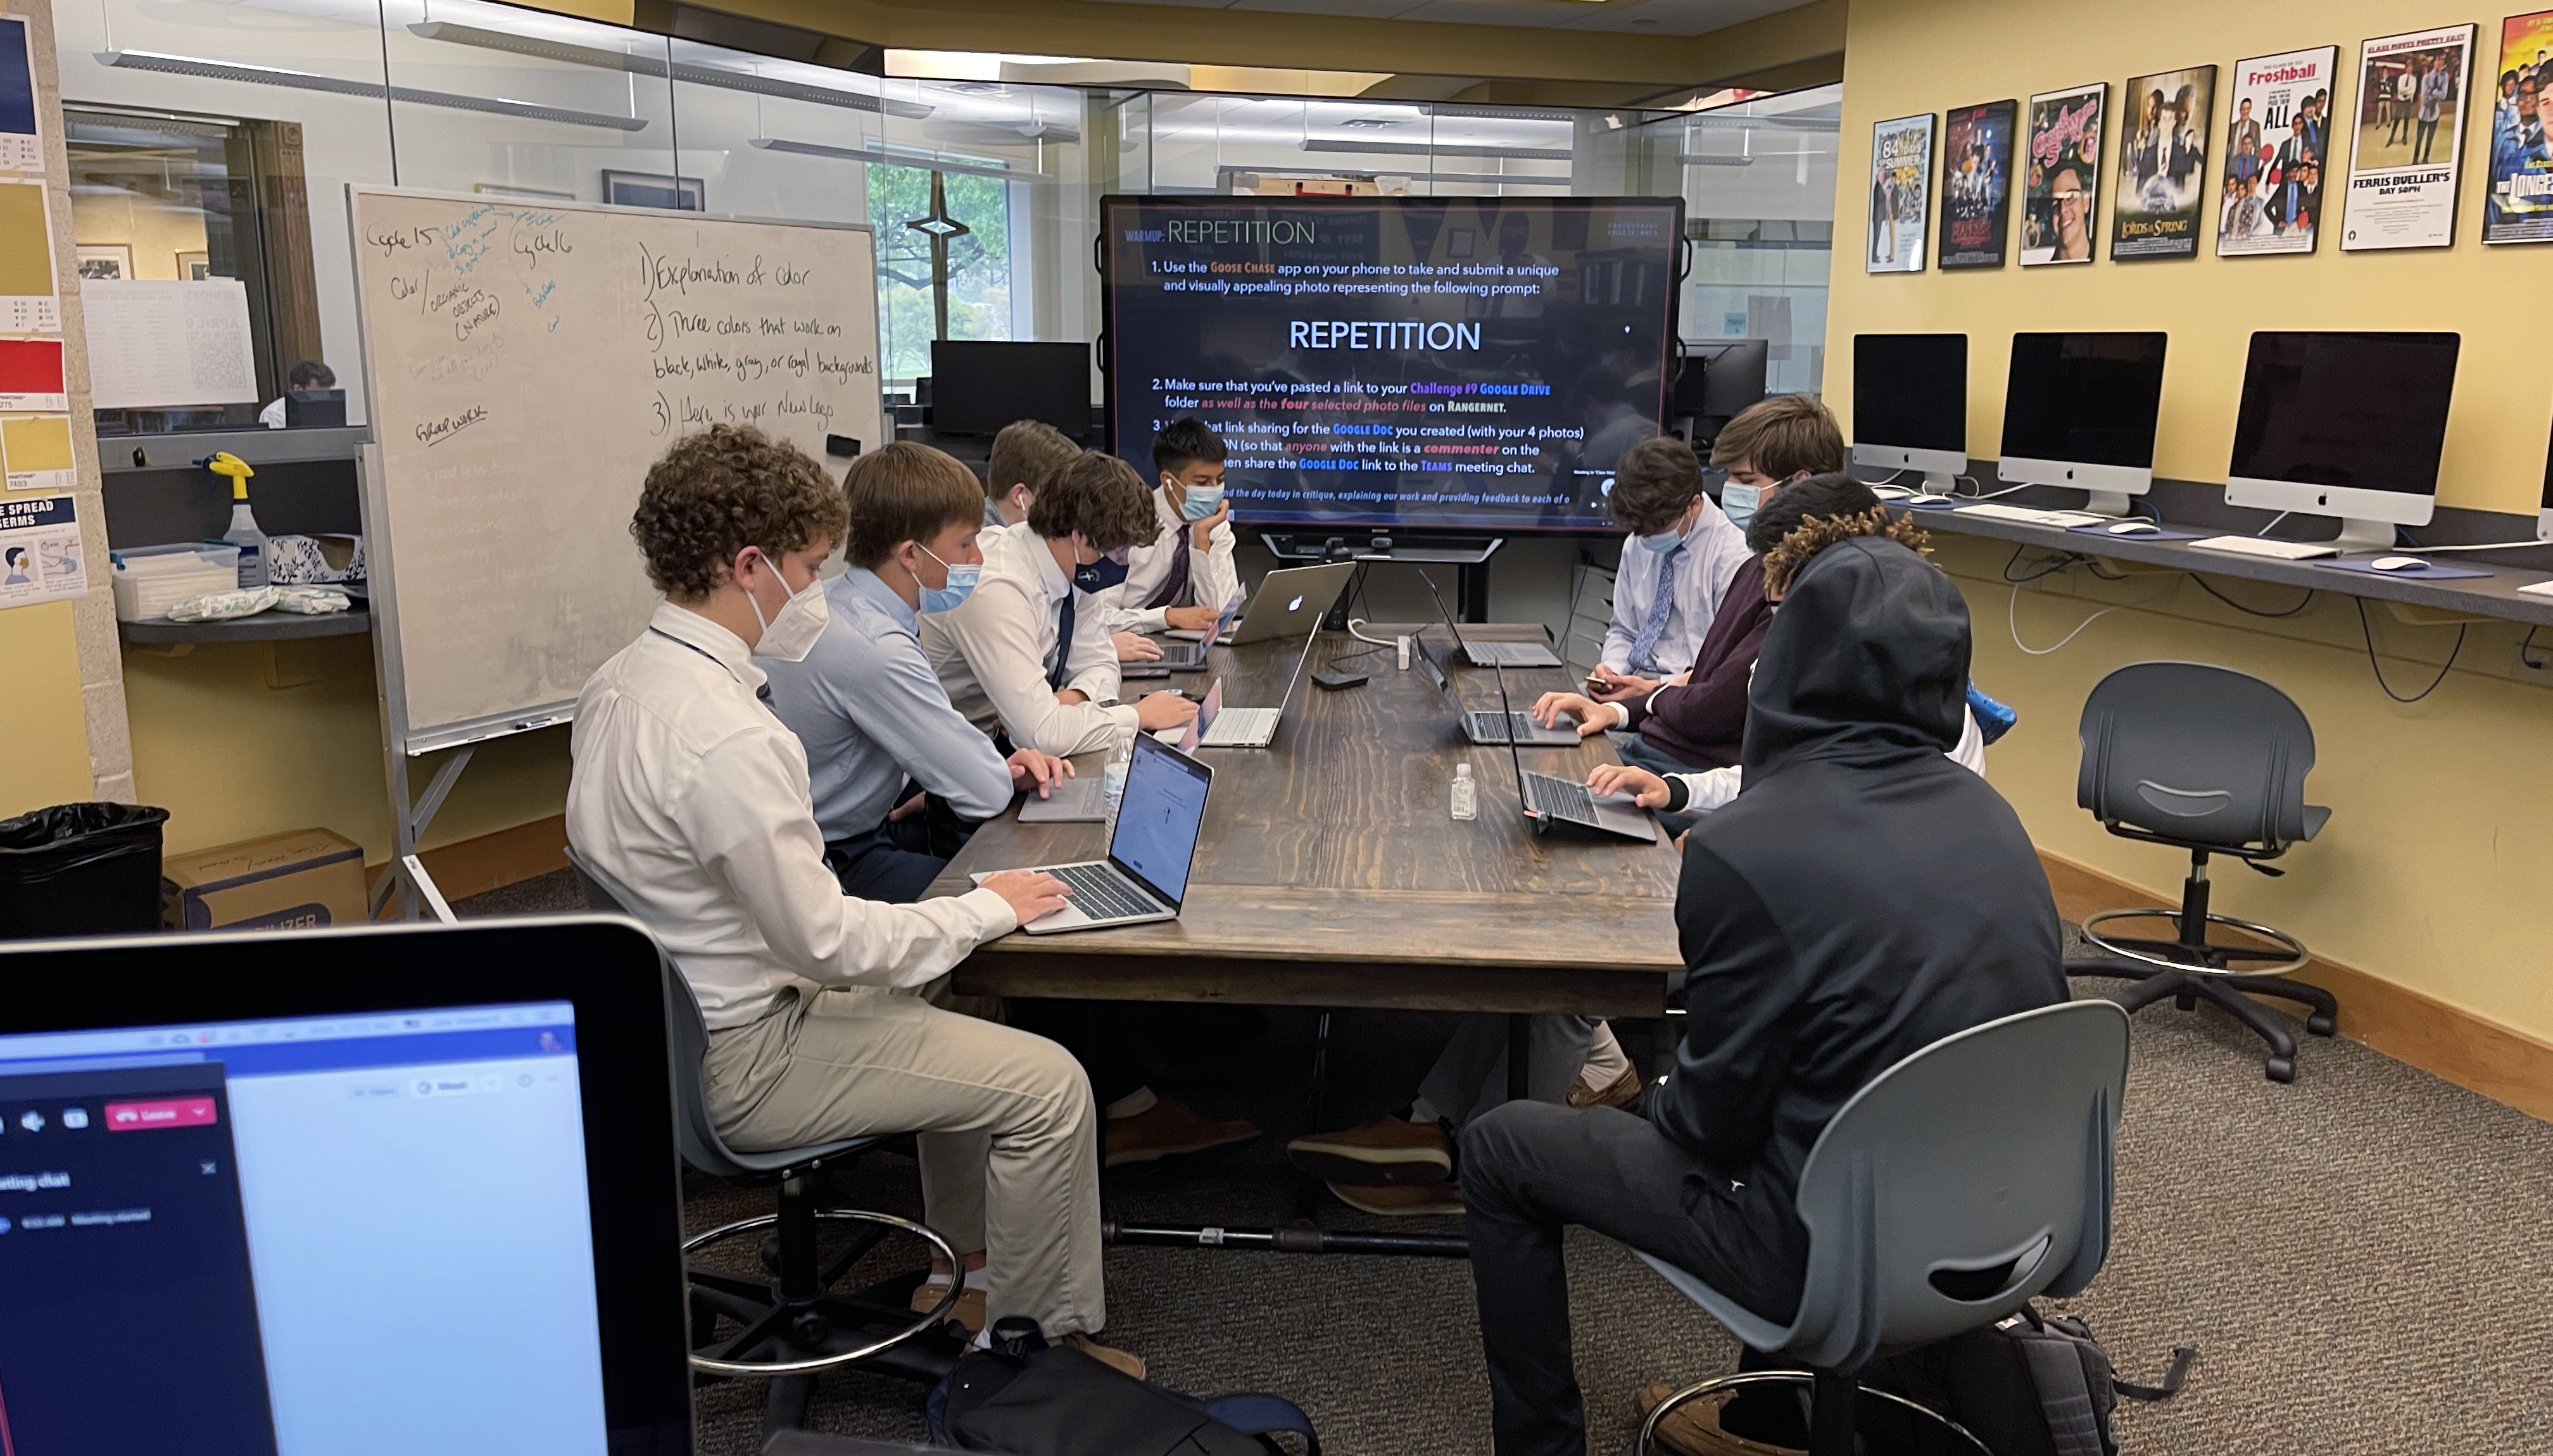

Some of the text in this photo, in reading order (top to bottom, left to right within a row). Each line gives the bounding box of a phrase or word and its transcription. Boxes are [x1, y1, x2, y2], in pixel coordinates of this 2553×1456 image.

[2445, 34, 2466, 42] FAST
[2248, 63, 2316, 86] Froshball
[2264, 105, 2290, 130] ALL
[1882, 141, 1922, 158] 84 DAYS
[1886, 154, 1920, 169] SUMMER
[2354, 172, 2450, 189] FERRIS BUELLER'S
[2398, 185, 2421, 194] SOPH
[1125, 220, 1315, 245] WARMUP: REPETITION
[2122, 220, 2188, 239] LORDS SPRING
[367, 222, 411, 258] Cycle
[514, 231, 555, 270] Cycle
[747, 254, 766, 286] of
[1152, 260, 1559, 279] 1. Use the GOOSE CHASE app on your phone to take and submit a unique
[1164, 279, 1540, 297] and visually appealing photo representing the following prompt:
[453, 289, 485, 317] OBJECTS
[644, 300, 842, 353] 2) Three colors that work on
[1290, 320, 1482, 351] REPETITION
[654, 355, 694, 380] black,
[697, 353, 731, 373] white,
[771, 355, 785, 368] or
[788, 348, 810, 377] royal
[817, 351, 874, 386] backgrounds
[1152, 379, 1163, 391] 2.
[1165, 379, 1195, 391] Make
[1199, 382, 1223, 391] sure
[1225, 380, 1248, 392] that
[1251, 380, 1288, 395] you've
[1290, 381, 1330, 395] pasted
[1333, 384, 1340, 392] a
[1344, 381, 1363, 394] link
[1366, 384, 1378, 394] to
[1381, 384, 1407, 397] your
[1410, 382, 1463, 398] Challenge
[1480, 383, 1518, 396] GOOGLE
[1520, 384, 1551, 396] DRIVE
[650, 390, 671, 436] 3)
[724, 399, 735, 422] is
[1164, 396, 1506, 413] folder as well as the four selected photo files on RANGERNET.
[1225, 420, 1245, 433] link
[1247, 422, 1290, 437] sharing
[1292, 422, 1308, 435] for
[1311, 422, 1330, 435] the
[1333, 424, 1370, 435] GOOGLE
[1373, 424, 1393, 436] DOC
[1396, 425, 1418, 439] you
[1420, 425, 1465, 437] created
[1467, 425, 1496, 439] (with
[1498, 427, 1525, 441] your
[1527, 426, 1536, 437] 4
[1539, 426, 1584, 441] photos)
[1240, 439, 1540, 456] (so that anyone with the link is a commenter on the
[1244, 457, 1535, 475] share the GOOGLE DOC link to the TEAMS meeting chat.
[1237, 488, 1564, 505] the day today in critique, explaining our work and providing feedback to each of
[8, 500, 54, 515] SPREAD
